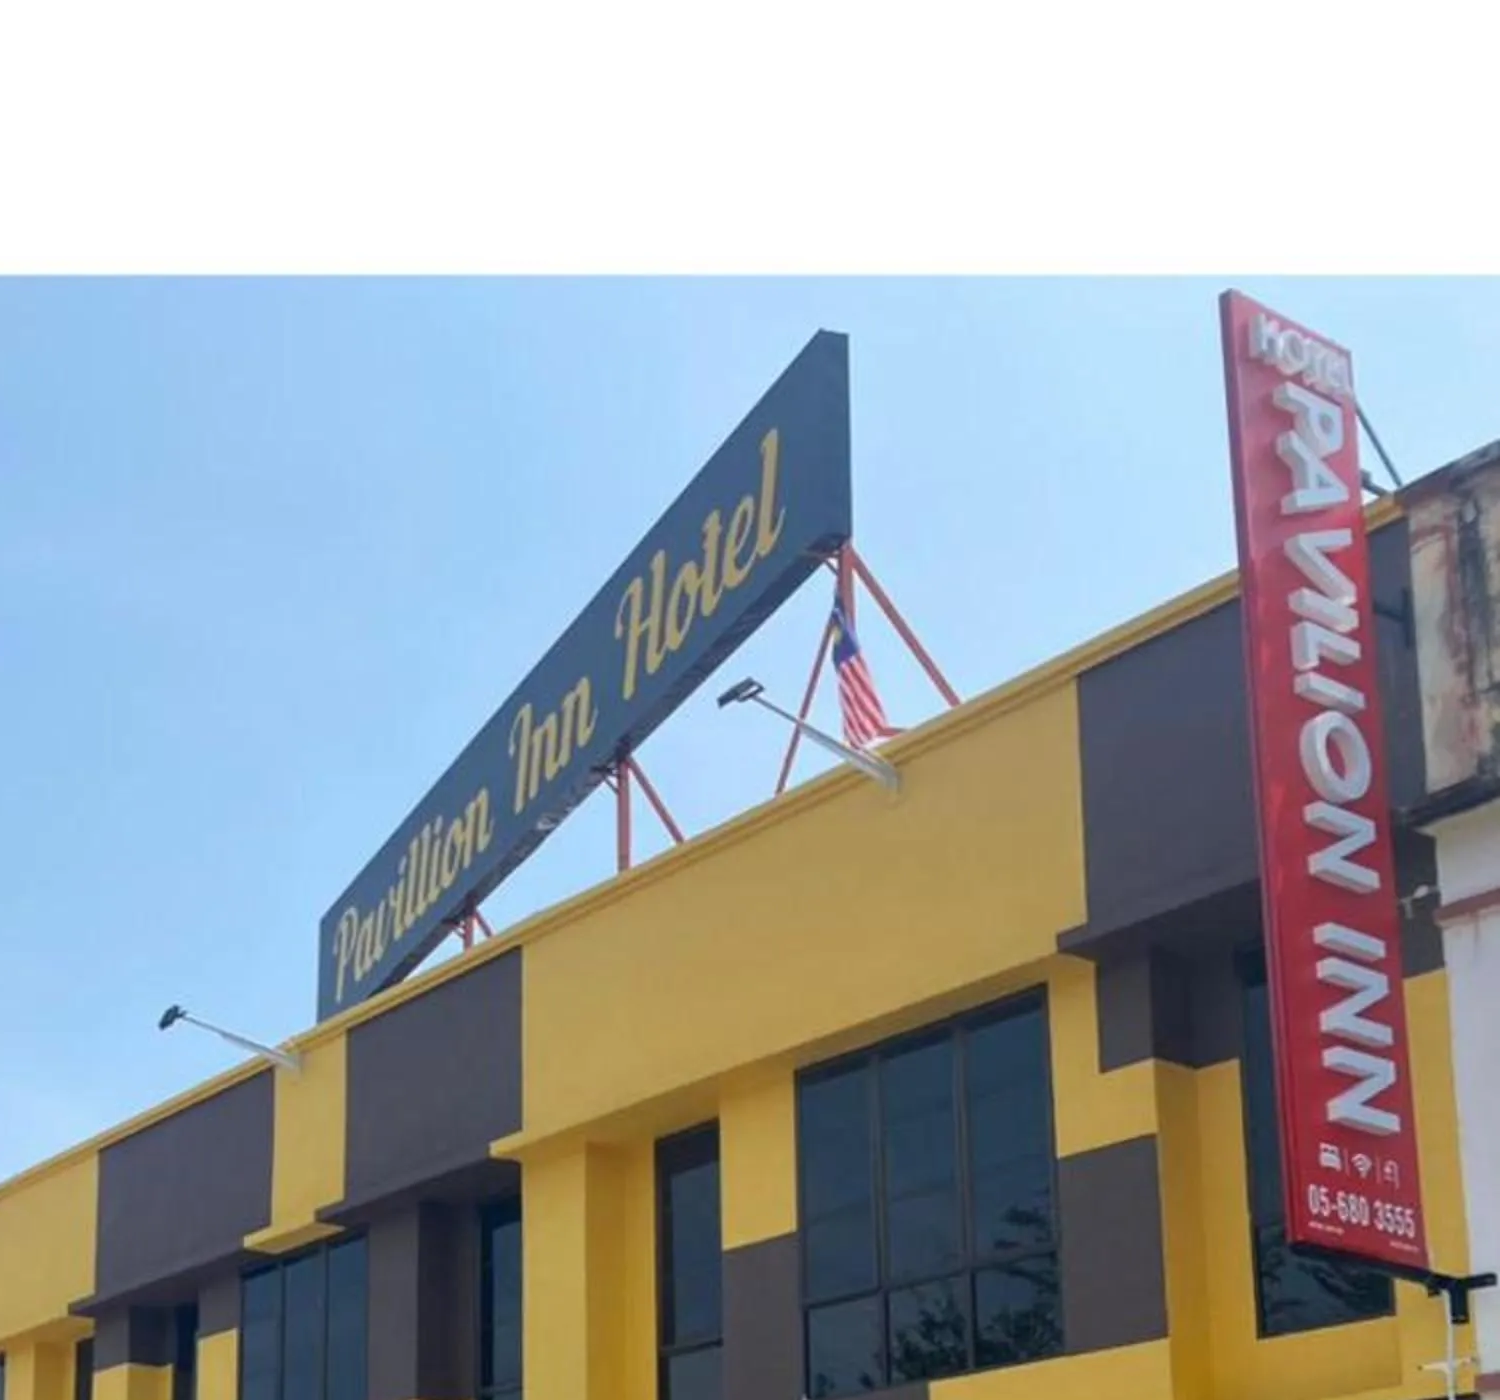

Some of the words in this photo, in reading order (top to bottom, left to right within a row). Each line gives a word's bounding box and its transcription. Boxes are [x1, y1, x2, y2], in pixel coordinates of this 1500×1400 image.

[508, 676, 598, 815] Inn
[614, 427, 786, 701] Hotel
[1271, 380, 1381, 894] PAVILION
[1312, 920, 1401, 1137] INN
[1307, 1183, 1371, 1227] 05-680
